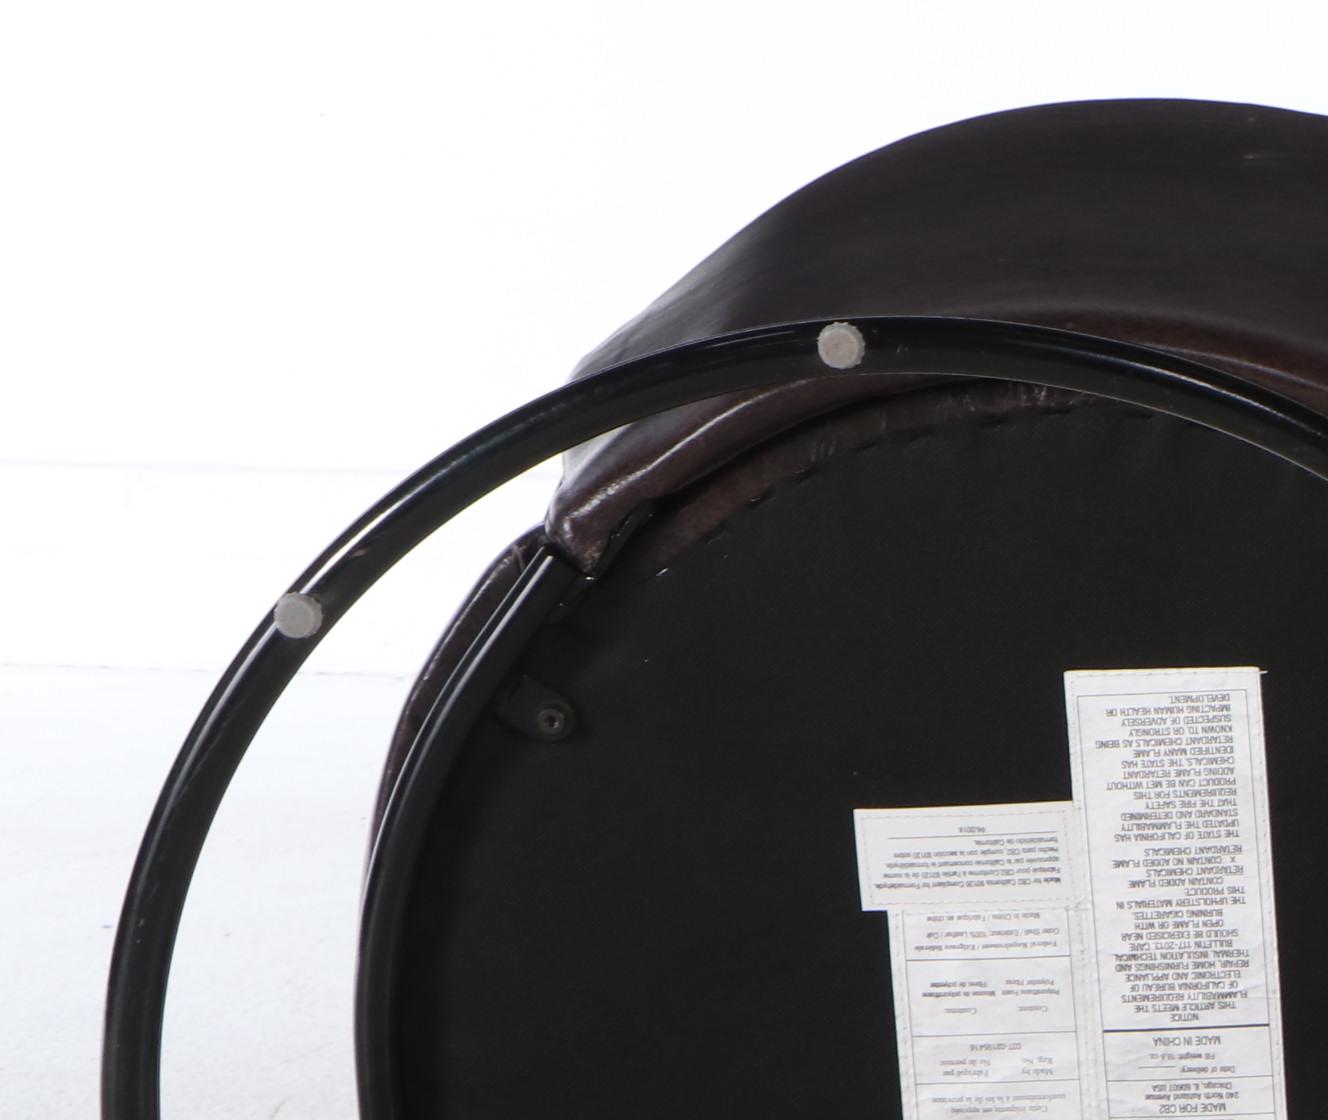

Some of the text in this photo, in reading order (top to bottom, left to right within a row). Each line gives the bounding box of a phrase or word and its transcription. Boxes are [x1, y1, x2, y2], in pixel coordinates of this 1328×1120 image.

[1186, 909, 1223, 918] BURNING
[1134, 922, 1156, 930] WITH
[1172, 921, 1200, 929] FLAME
[1202, 920, 1223, 928] OPEN
[1121, 929, 1238, 941] SHOULD BE EXERCISED NEAR
[1129, 942, 1151, 950] CARE
[1194, 940, 1232, 948] BULLETIN
[1160, 951, 1210, 960] INSULATION
[1213, 950, 1249, 958] THERMAL
[1135, 962, 1190, 971] FURNISHINGS
[1192, 961, 1216, 969] HOME
[1125, 970, 1240, 982] ELECTRONIC AND APPLIANCE
[1129, 984, 1140, 992] OF
[1142, 983, 1176, 991] BUREAU
[1178, 981, 1226, 990] CALIFORNIA
[1121, 991, 1247, 1002] FLAMMABILITY REQUIREMENTS
[1134, 1001, 1235, 1012] THIS ARTICLE MEETS THE
[1170, 1013, 1199, 1021] NOTICE
[1153, 1036, 1220, 1046] MADE IN CHINA
[1159, 1103, 1225, 1113] MADE FOR CB2
